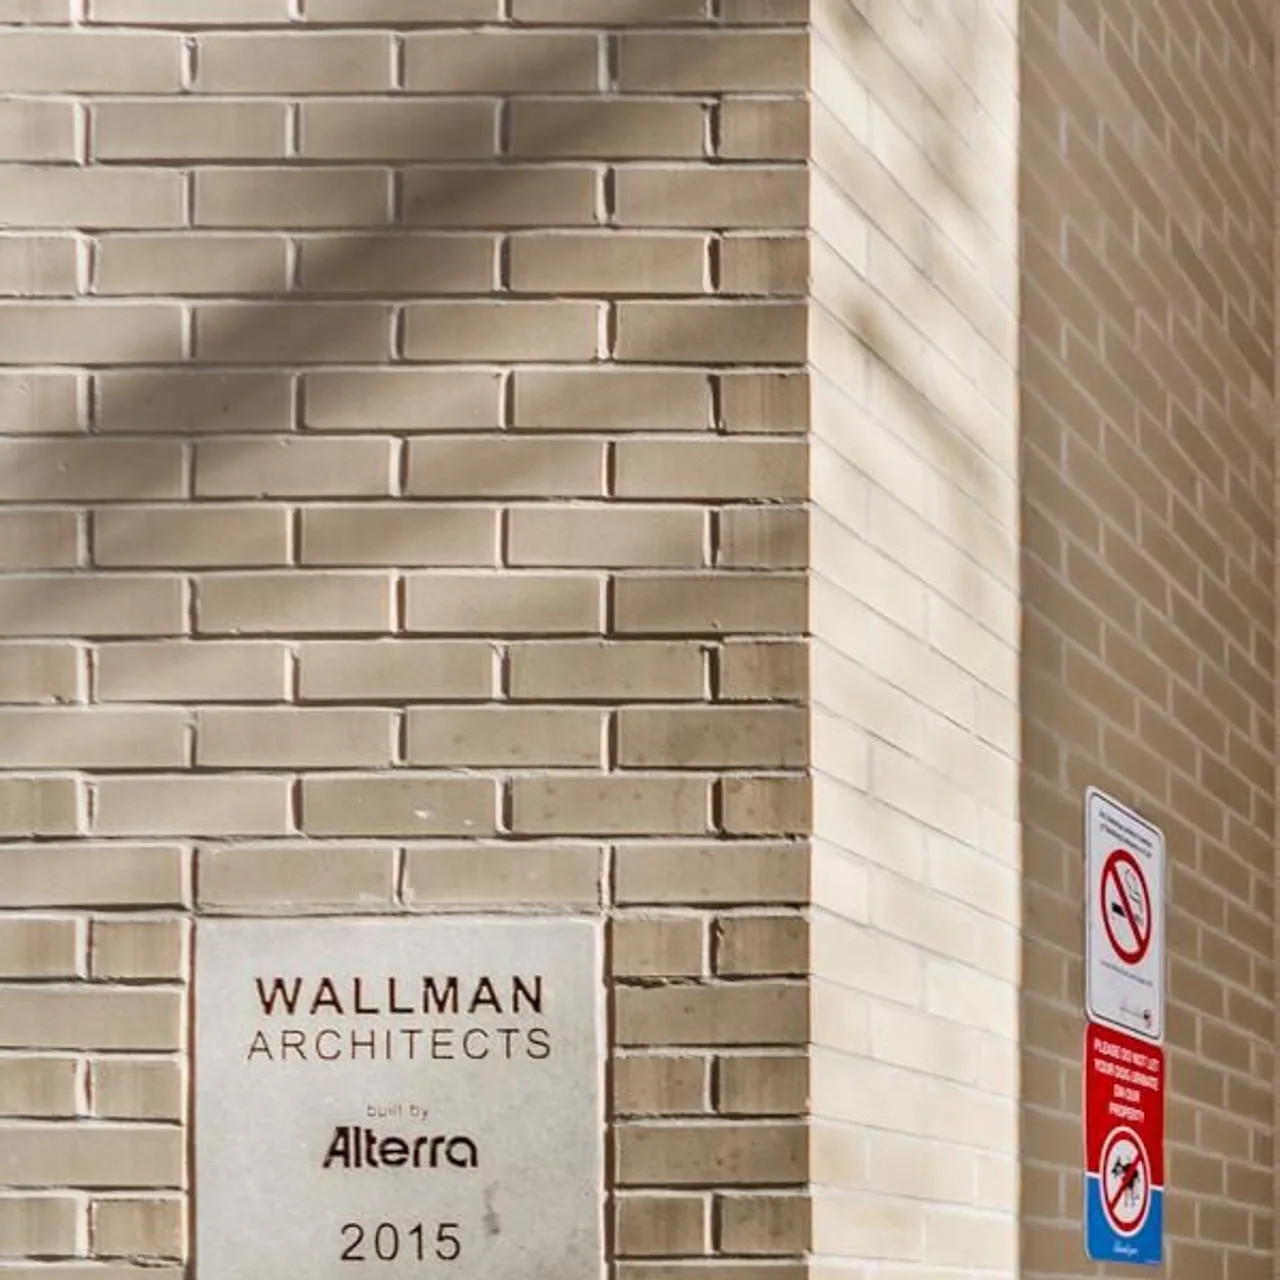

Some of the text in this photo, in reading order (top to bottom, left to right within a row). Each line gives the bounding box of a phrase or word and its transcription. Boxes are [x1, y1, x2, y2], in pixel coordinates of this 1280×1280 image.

[255, 975, 543, 1016] WALLMAN
[247, 1027, 552, 1062] ARCHITECTS
[409, 1104, 429, 1121] by
[322, 1126, 479, 1169] Alterra
[341, 1222, 462, 1262] 2015
